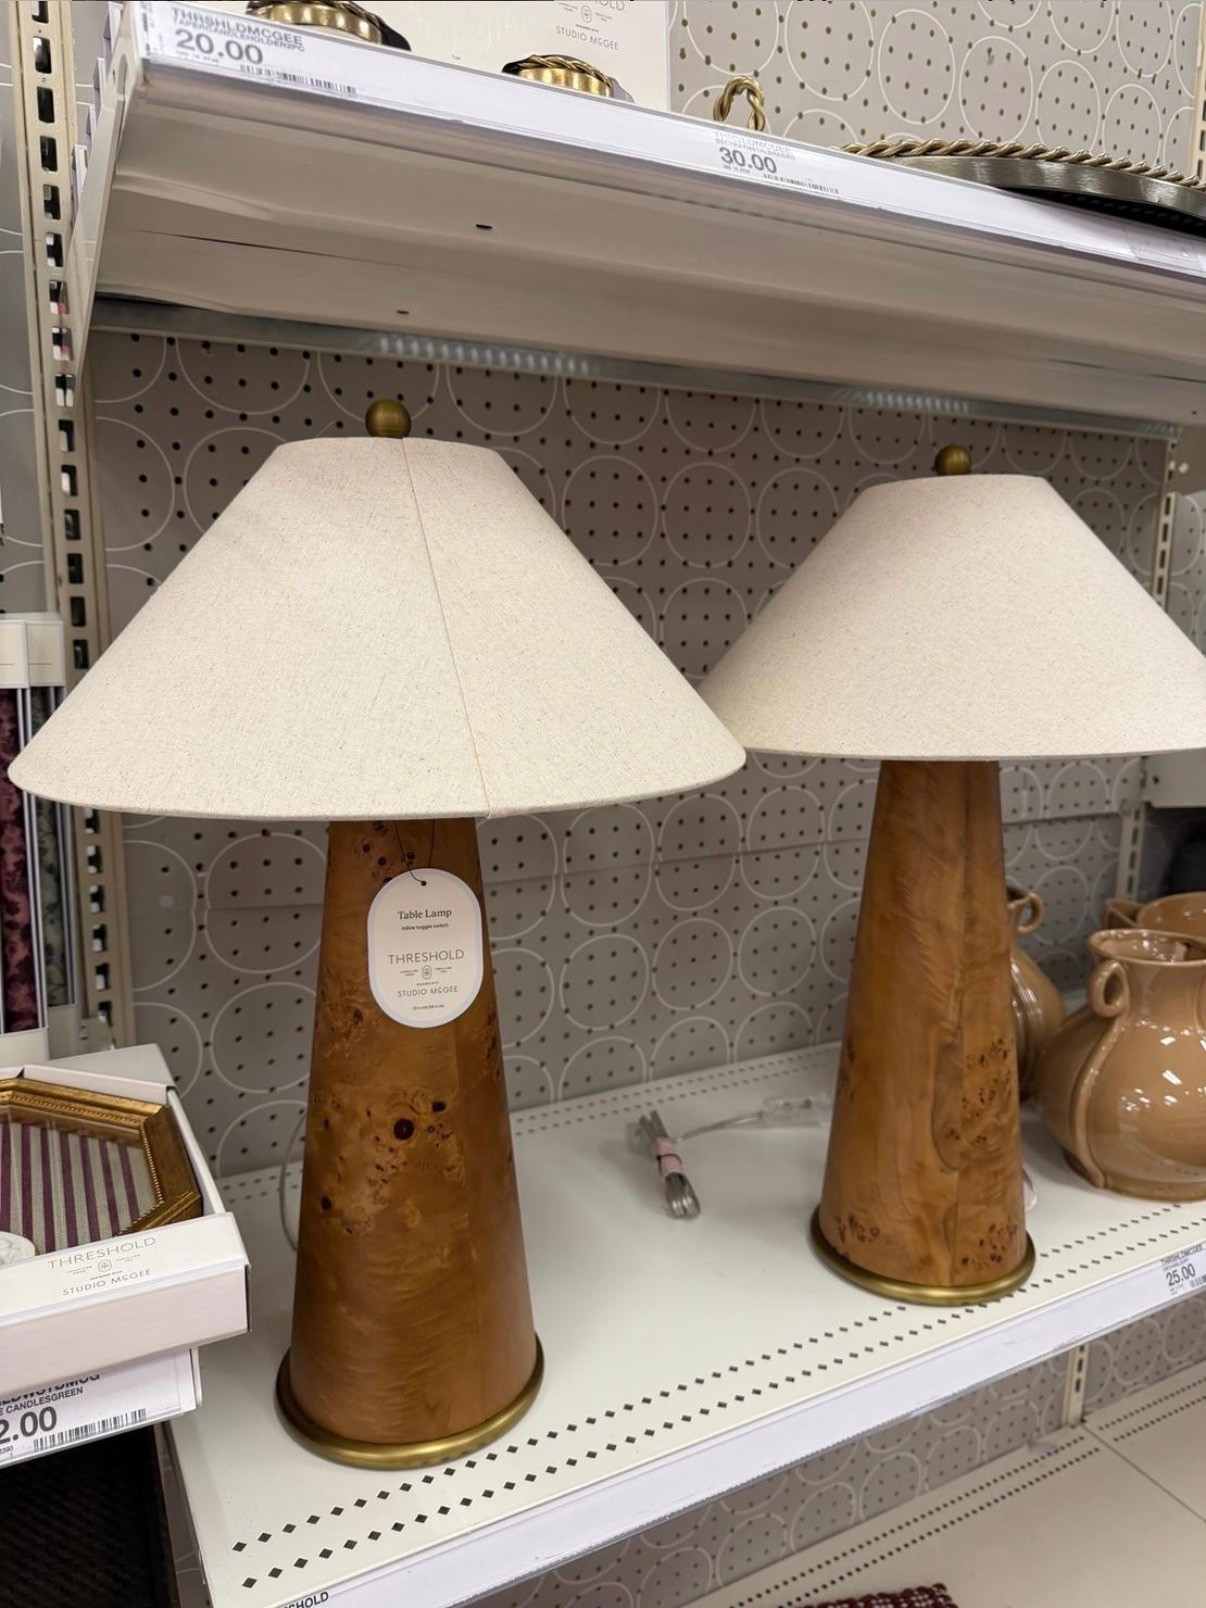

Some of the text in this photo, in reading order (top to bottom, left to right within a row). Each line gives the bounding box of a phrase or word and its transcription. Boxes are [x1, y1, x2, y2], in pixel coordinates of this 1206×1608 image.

[556, 25, 587, 41] STUDIO
[175, 28, 263, 65] 20.00
[719, 147, 777, 173] 30.00
[397, 909, 452, 920] Table Lamp
[388, 949, 465, 965] THRESHOLD
[397, 988, 428, 998] STUDIO
[48, 1236, 156, 1269] THRESHOLD
[1166, 1263, 1196, 1286] 25.00
[61, 1279, 106, 1296] STUDIO
[6, 1386, 83, 1414] CANDLESGREEN
